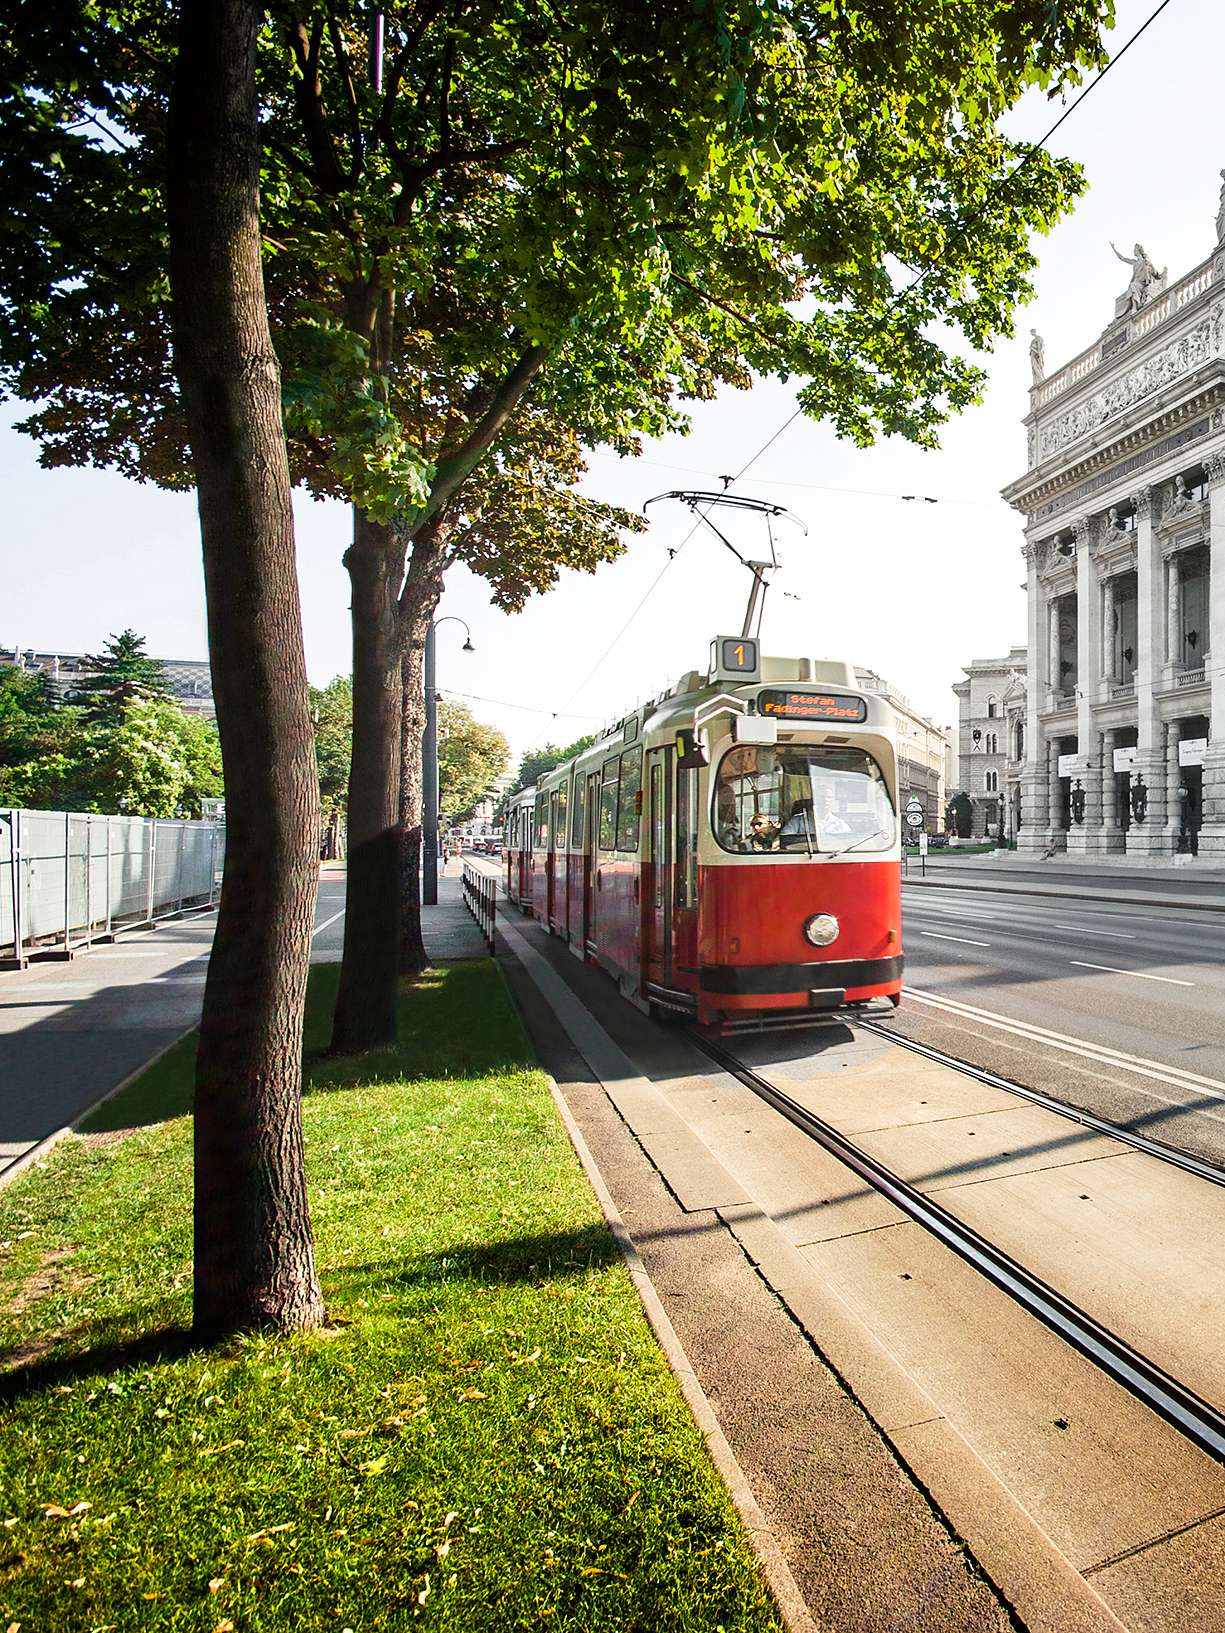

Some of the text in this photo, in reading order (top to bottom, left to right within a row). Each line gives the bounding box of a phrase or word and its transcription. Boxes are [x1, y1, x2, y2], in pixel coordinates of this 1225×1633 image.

[734, 644, 744, 666] 1
[790, 694, 835, 706] Stefan
[764, 703, 860, 717] Fadinger-Platz
